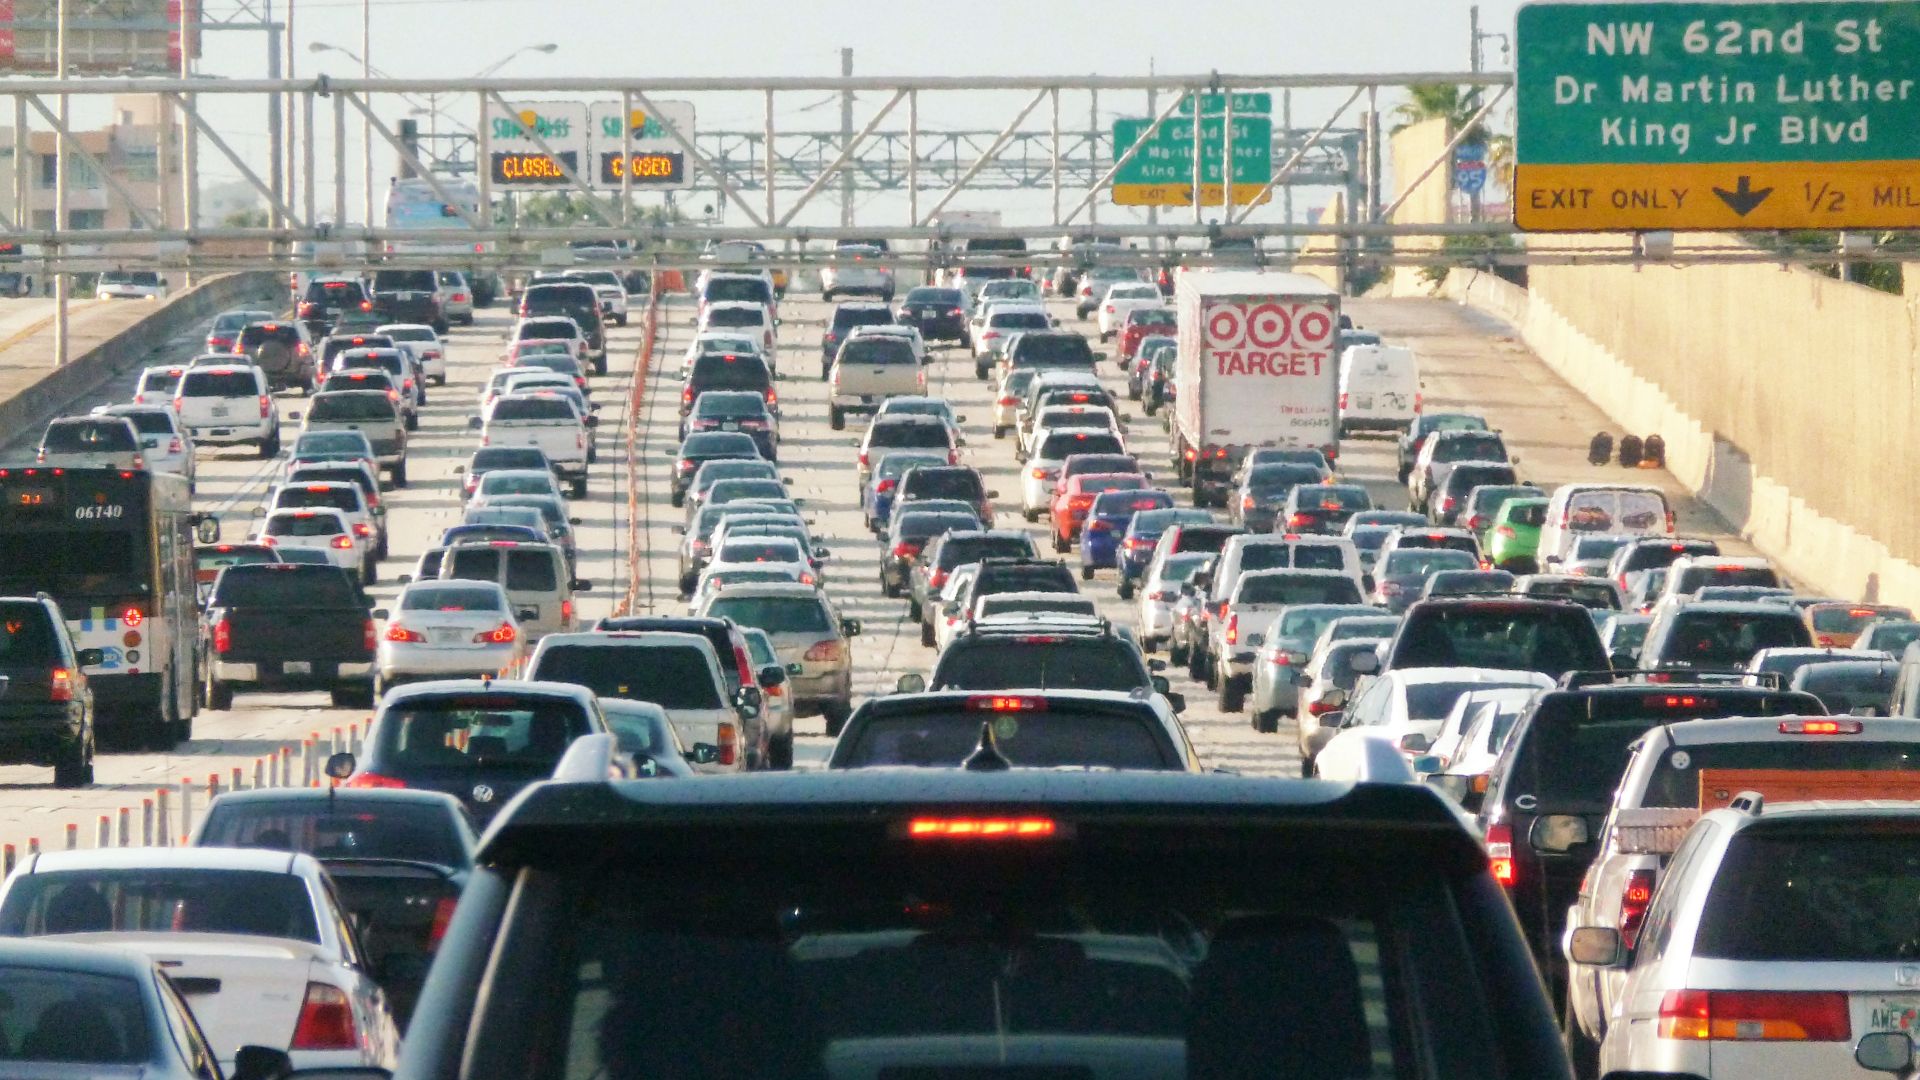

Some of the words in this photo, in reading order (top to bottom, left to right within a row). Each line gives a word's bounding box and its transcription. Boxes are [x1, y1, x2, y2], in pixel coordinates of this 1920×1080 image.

[1587, 21, 1654, 56] NW
[1682, 19, 1805, 55] 62nd
[1834, 18, 1883, 54] St
[1555, 75, 1598, 105] Dr
[1621, 74, 1757, 104] Martin
[1776, 73, 1915, 104] Luther
[1601, 117, 1691, 154] King
[1715, 116, 1757, 145] Jr
[1779, 115, 1869, 144] Blvd
[1531, 188, 1594, 209] EXIT
[1611, 188, 1690, 209] ONLY
[1212, 351, 1327, 376] TARGET
